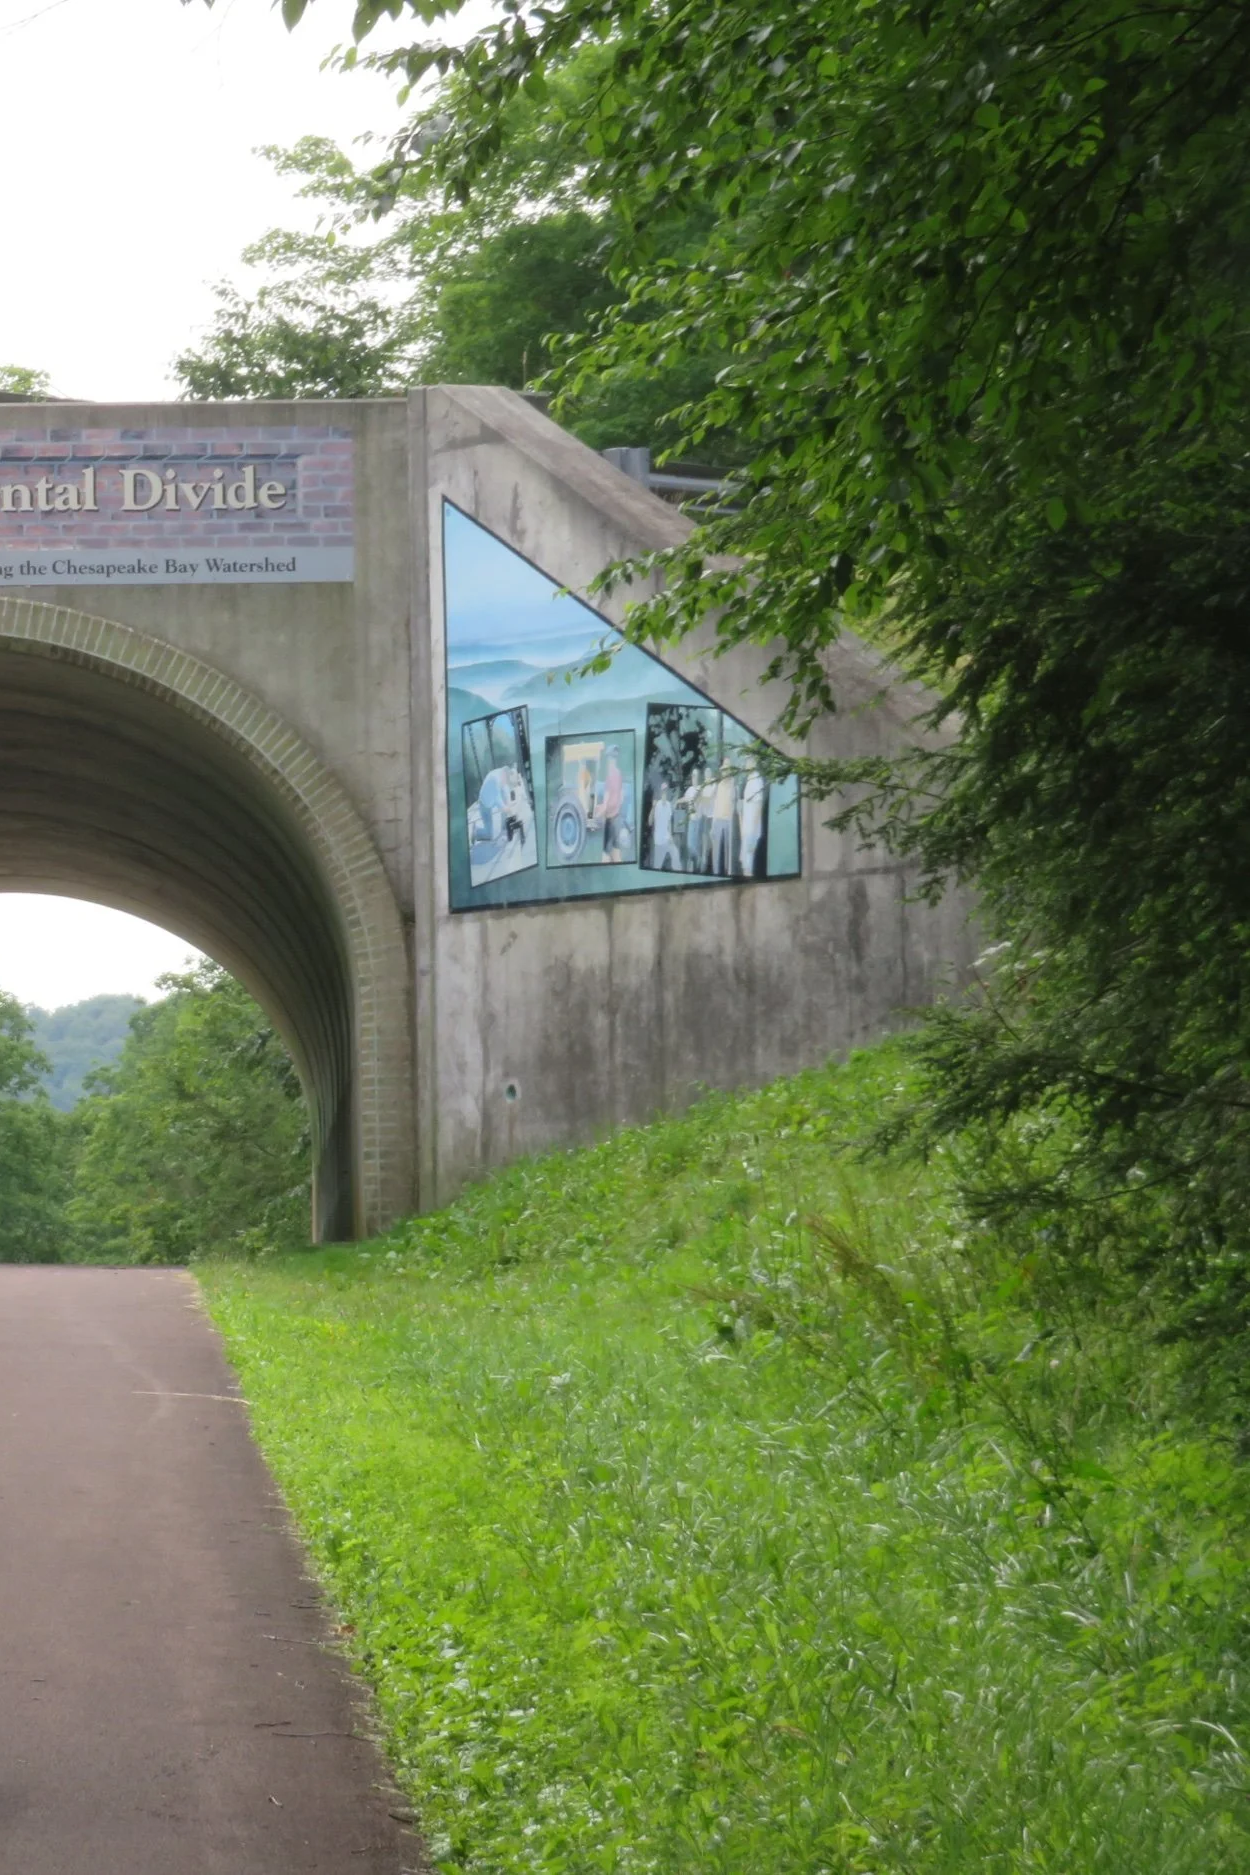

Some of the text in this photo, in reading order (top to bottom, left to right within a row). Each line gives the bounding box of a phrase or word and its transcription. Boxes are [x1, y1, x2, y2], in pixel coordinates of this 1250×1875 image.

[119, 464, 287, 513] Divide
[18, 560, 48, 577] the
[51, 558, 159, 578] Chesapeake
[164, 558, 199, 576] Bay
[204, 556, 297, 574] Watershed
